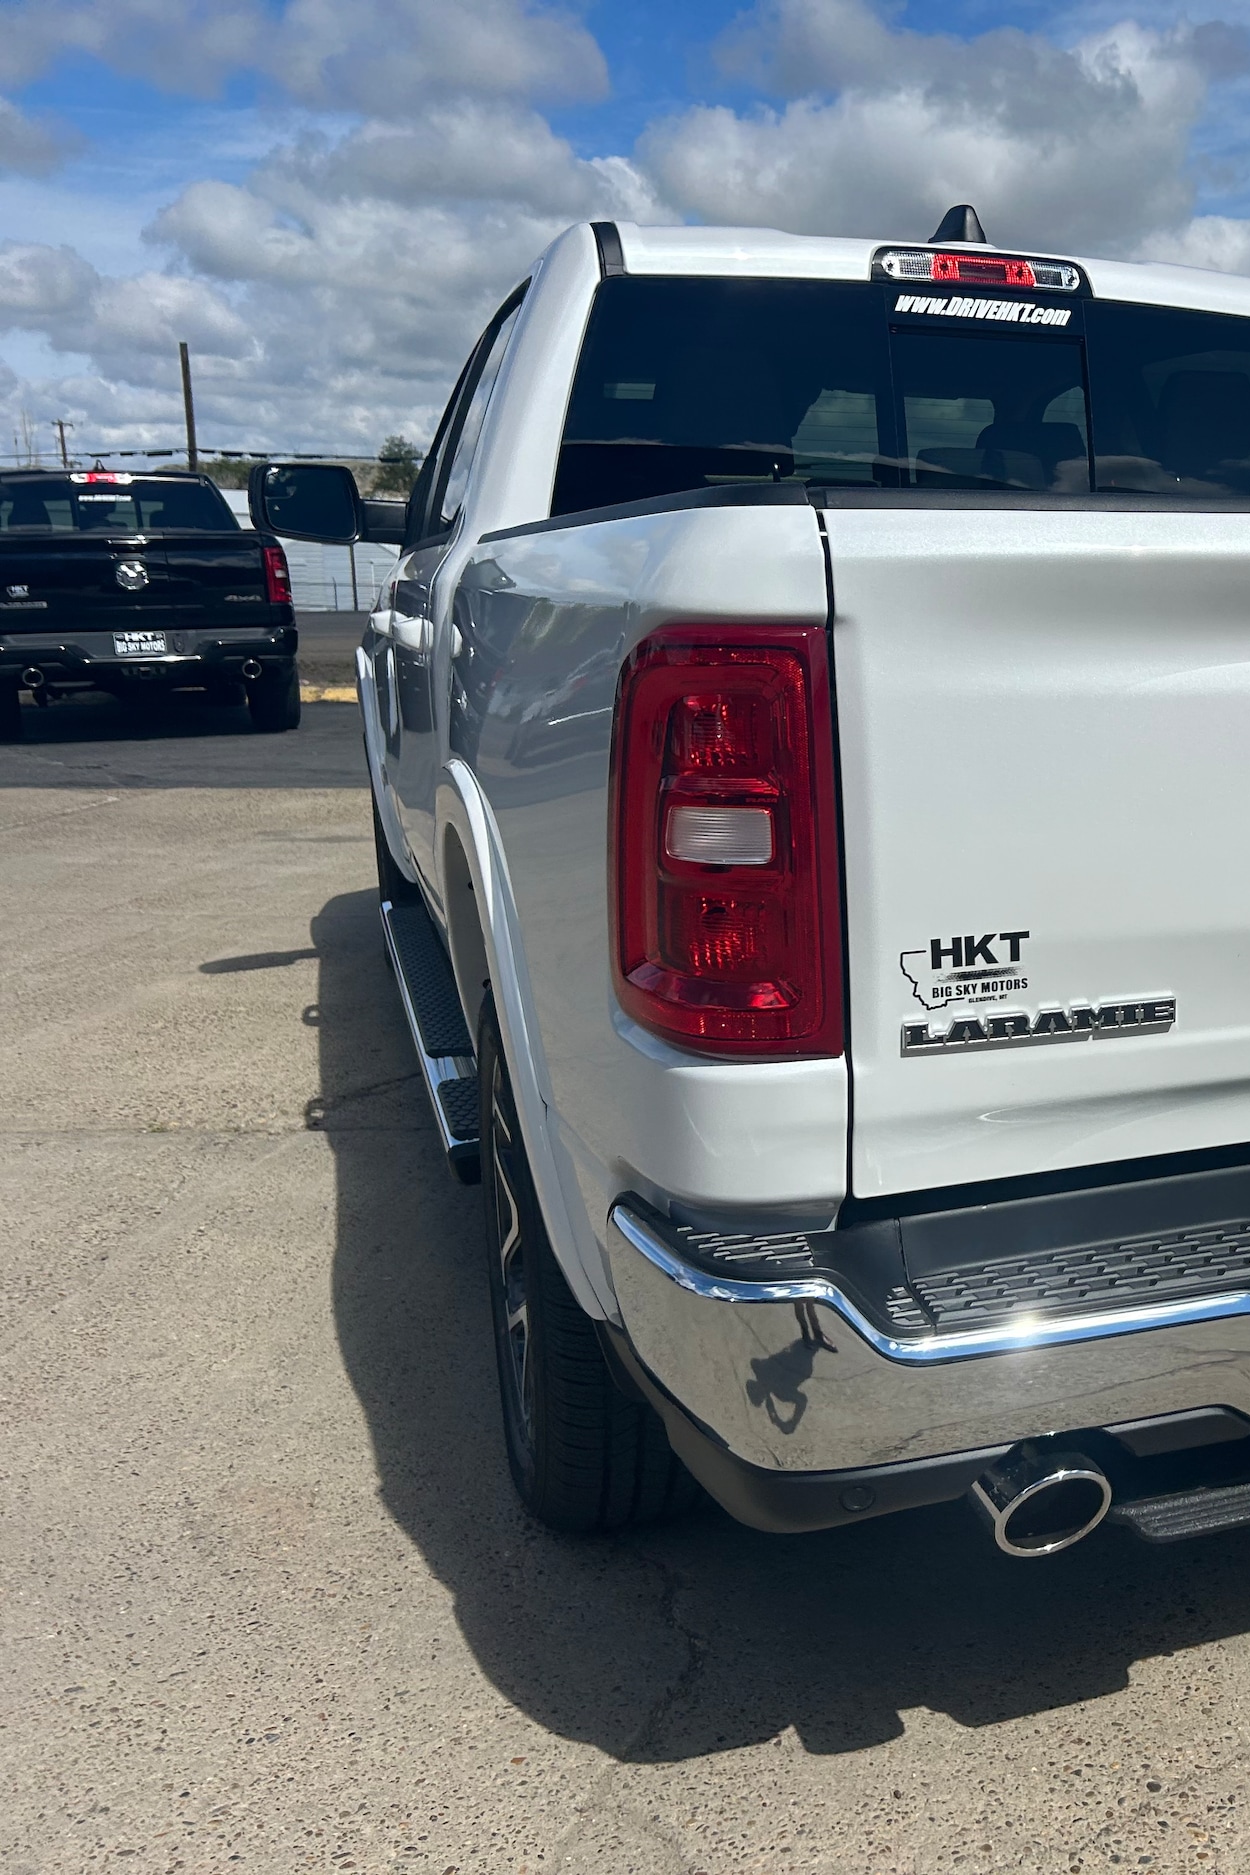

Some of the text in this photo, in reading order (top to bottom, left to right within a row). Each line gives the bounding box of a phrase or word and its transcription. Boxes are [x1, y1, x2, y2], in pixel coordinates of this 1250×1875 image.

[124, 632, 154, 641] HKT
[127, 641, 140, 651] SKY
[140, 640, 165, 651] MOTORS
[930, 930, 1030, 969] HKT
[932, 978, 1029, 998] BIG SKY MOTORS
[901, 996, 1176, 1058] LARAMIE
